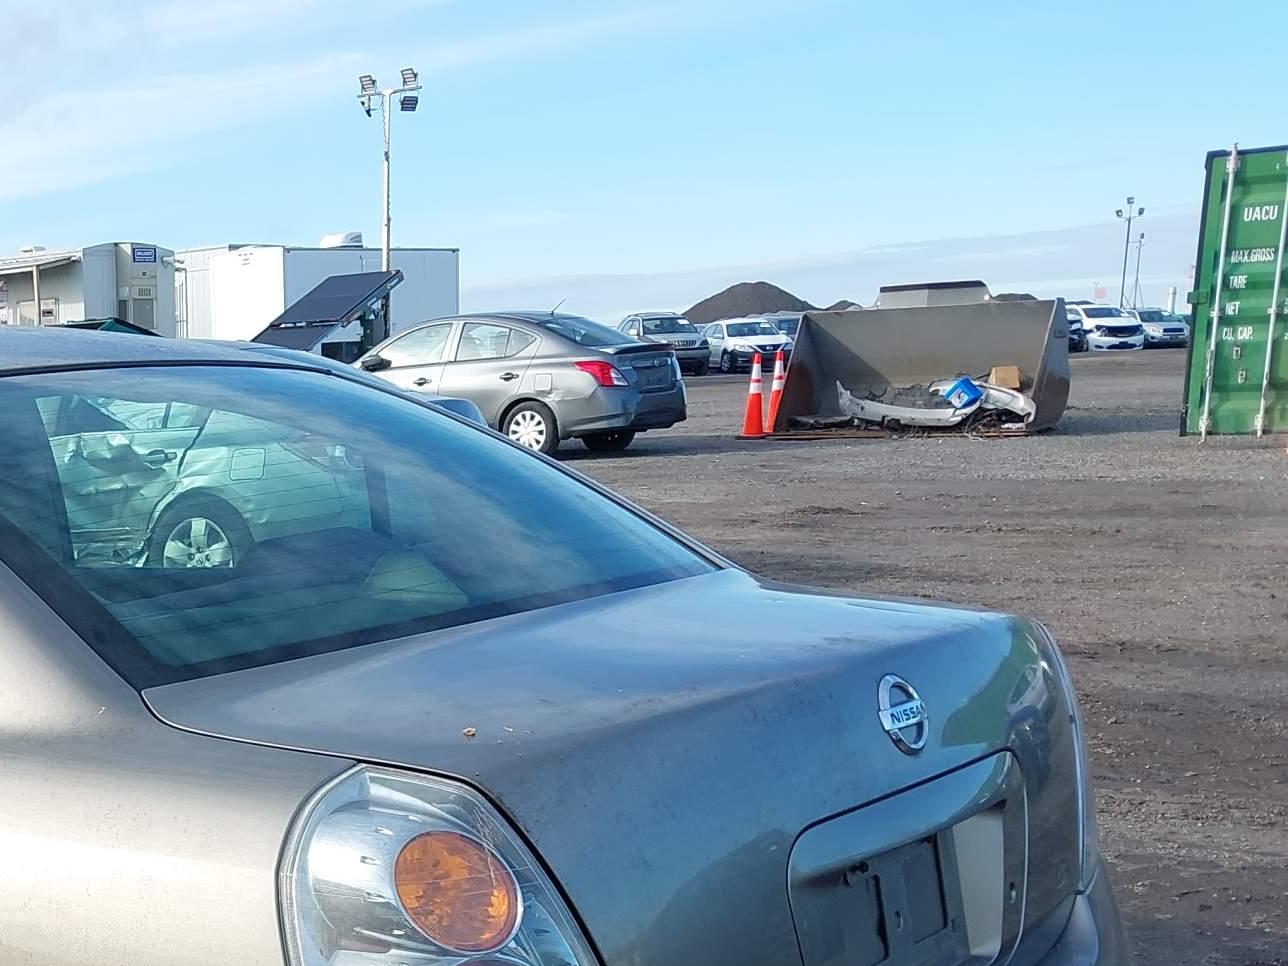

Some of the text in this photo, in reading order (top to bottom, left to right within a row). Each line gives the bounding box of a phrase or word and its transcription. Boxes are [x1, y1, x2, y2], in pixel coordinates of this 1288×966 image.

[1243, 204, 1279, 222] UACU
[1229, 274, 1248, 289] TARE
[1225, 301, 1240, 316] NET
[1237, 326, 1254, 340] CAP.
